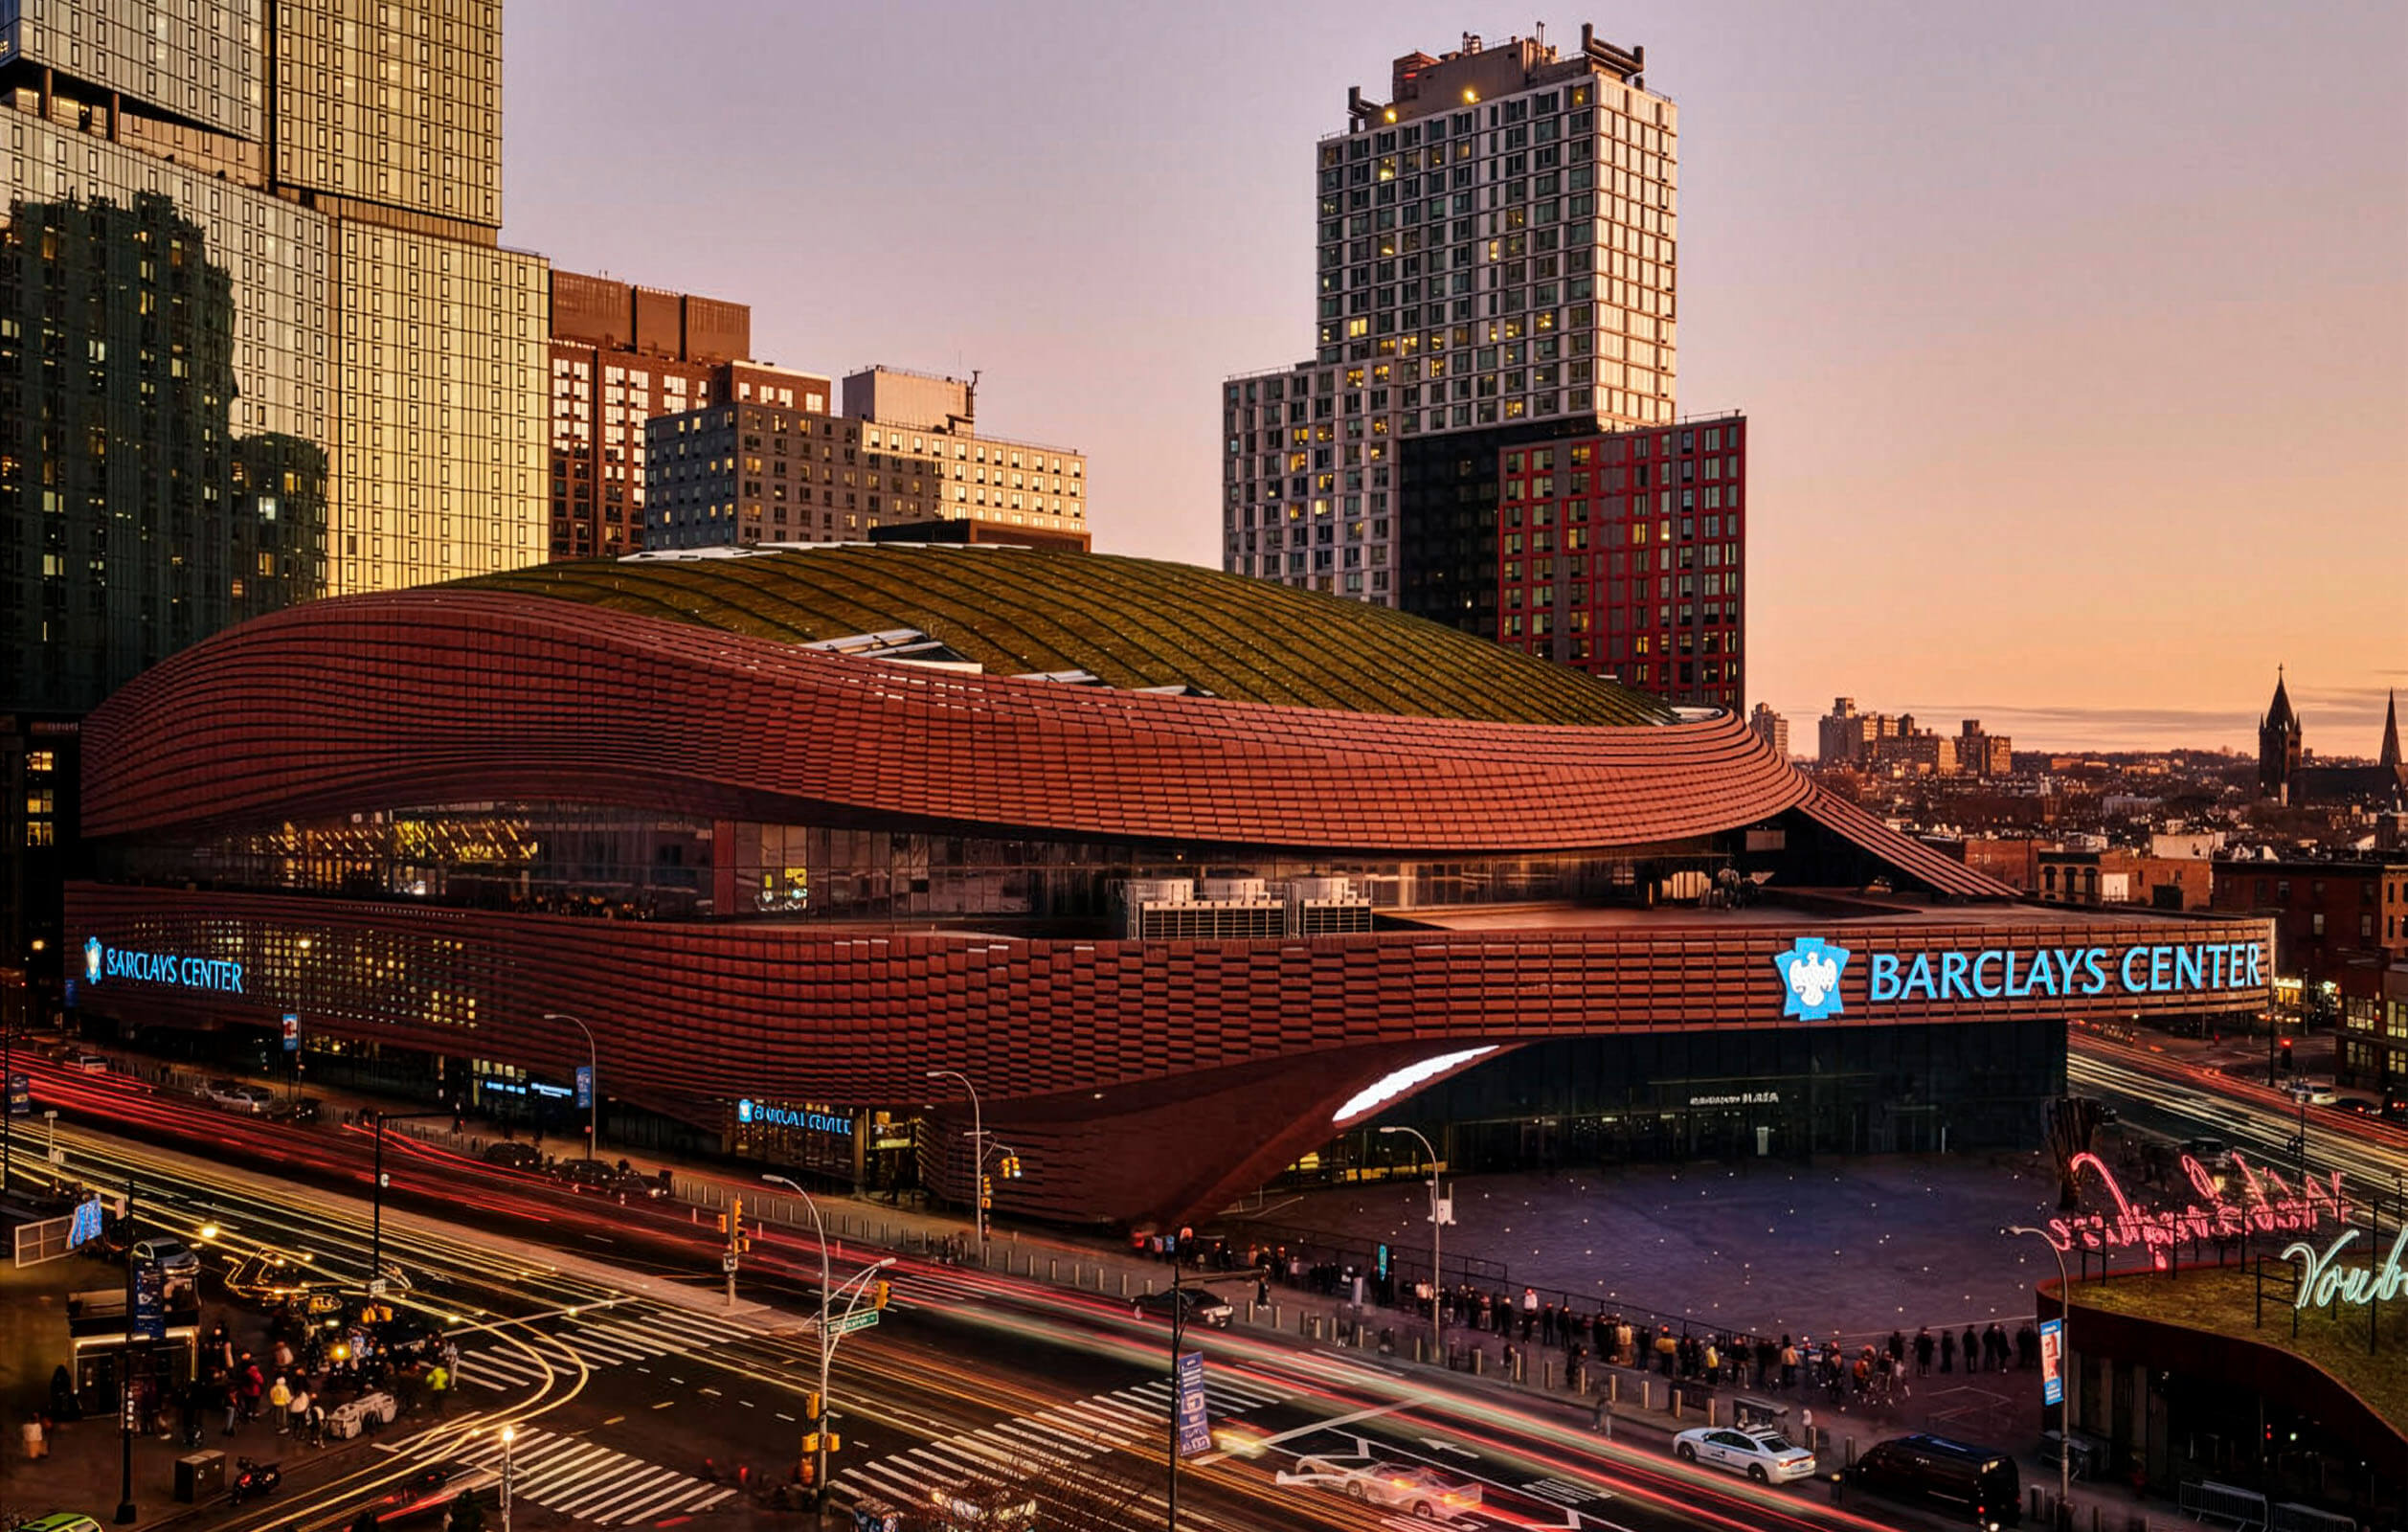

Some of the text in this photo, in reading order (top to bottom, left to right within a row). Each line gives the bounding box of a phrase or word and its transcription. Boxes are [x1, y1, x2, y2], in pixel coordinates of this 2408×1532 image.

[106, 947, 243, 994] BARCLAYS CENTER
[1870, 942, 2262, 1002] BARCLAYS CENTER
